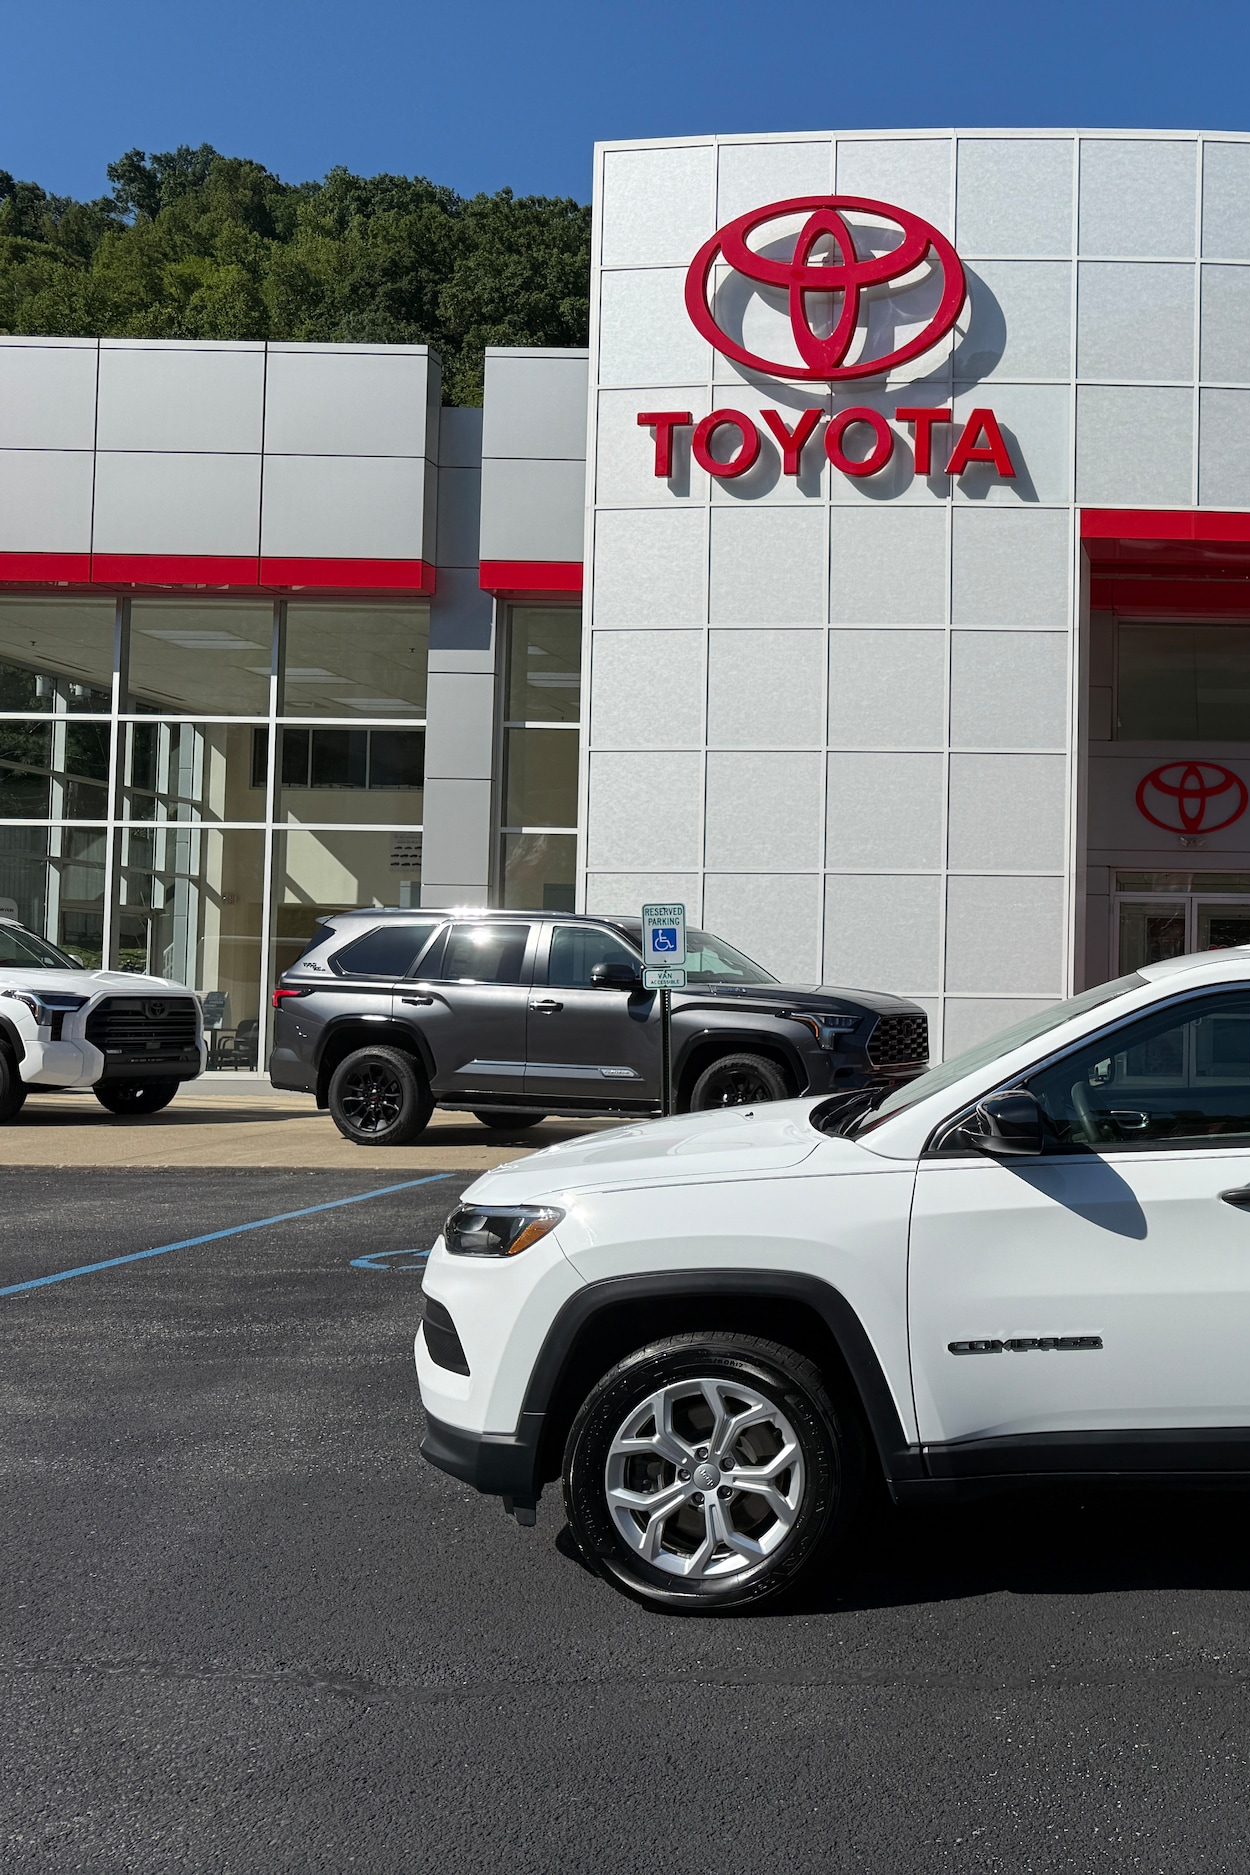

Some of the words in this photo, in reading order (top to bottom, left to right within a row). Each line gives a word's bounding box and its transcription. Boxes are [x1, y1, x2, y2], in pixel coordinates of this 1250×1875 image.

[637, 407, 1017, 479] TOYOTA
[644, 907, 683, 917] RESERVED
[648, 917, 680, 926] PARKING
